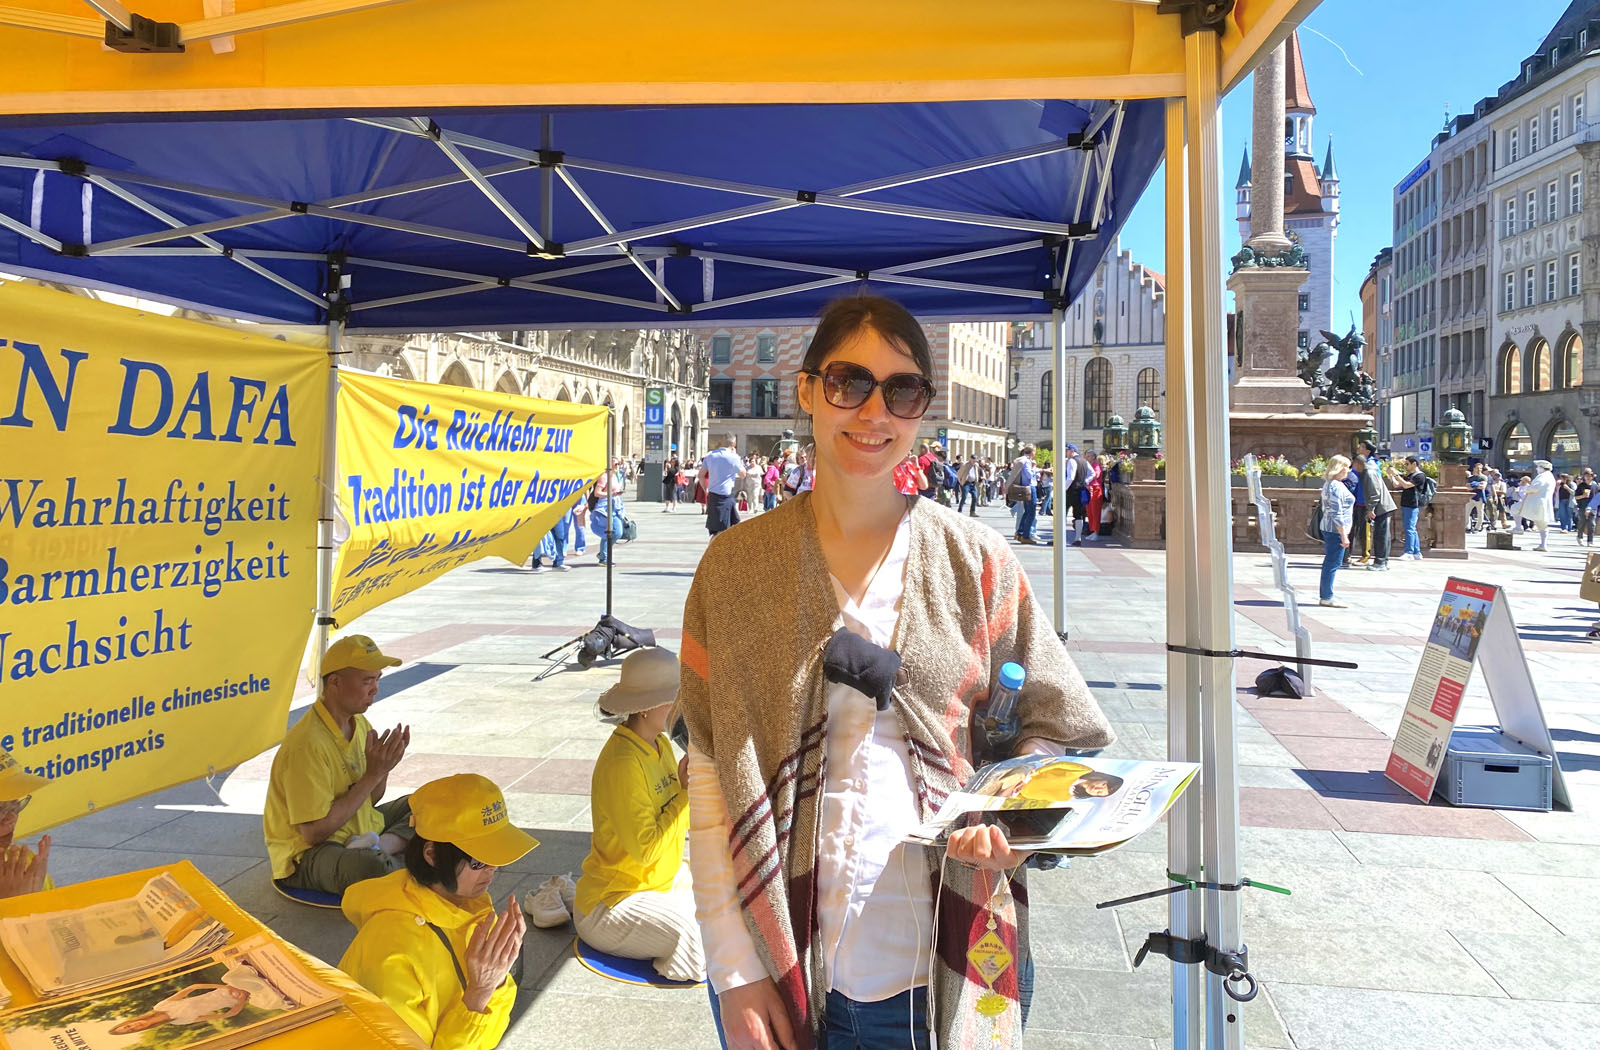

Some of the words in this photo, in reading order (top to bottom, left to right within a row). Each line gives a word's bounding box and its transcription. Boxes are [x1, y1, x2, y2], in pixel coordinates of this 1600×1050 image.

[0, 339, 89, 432] N
[107, 358, 297, 447] DAFA
[649, 390, 661, 404] S
[649, 408, 660, 422] U
[392, 403, 439, 450] Die
[446, 410, 543, 453] Rückkehr
[543, 428, 574, 453] zur
[0, 477, 289, 536] Wahrhaftigkeit
[348, 468, 452, 526] Tradition
[457, 468, 486, 512] ist
[489, 467, 522, 508] der
[522, 470, 592, 504] Auswe
[22, 696, 155, 748] traditionelle
[162, 674, 270, 712] chinesische
[64, 1027, 86, 1047] MITTE
